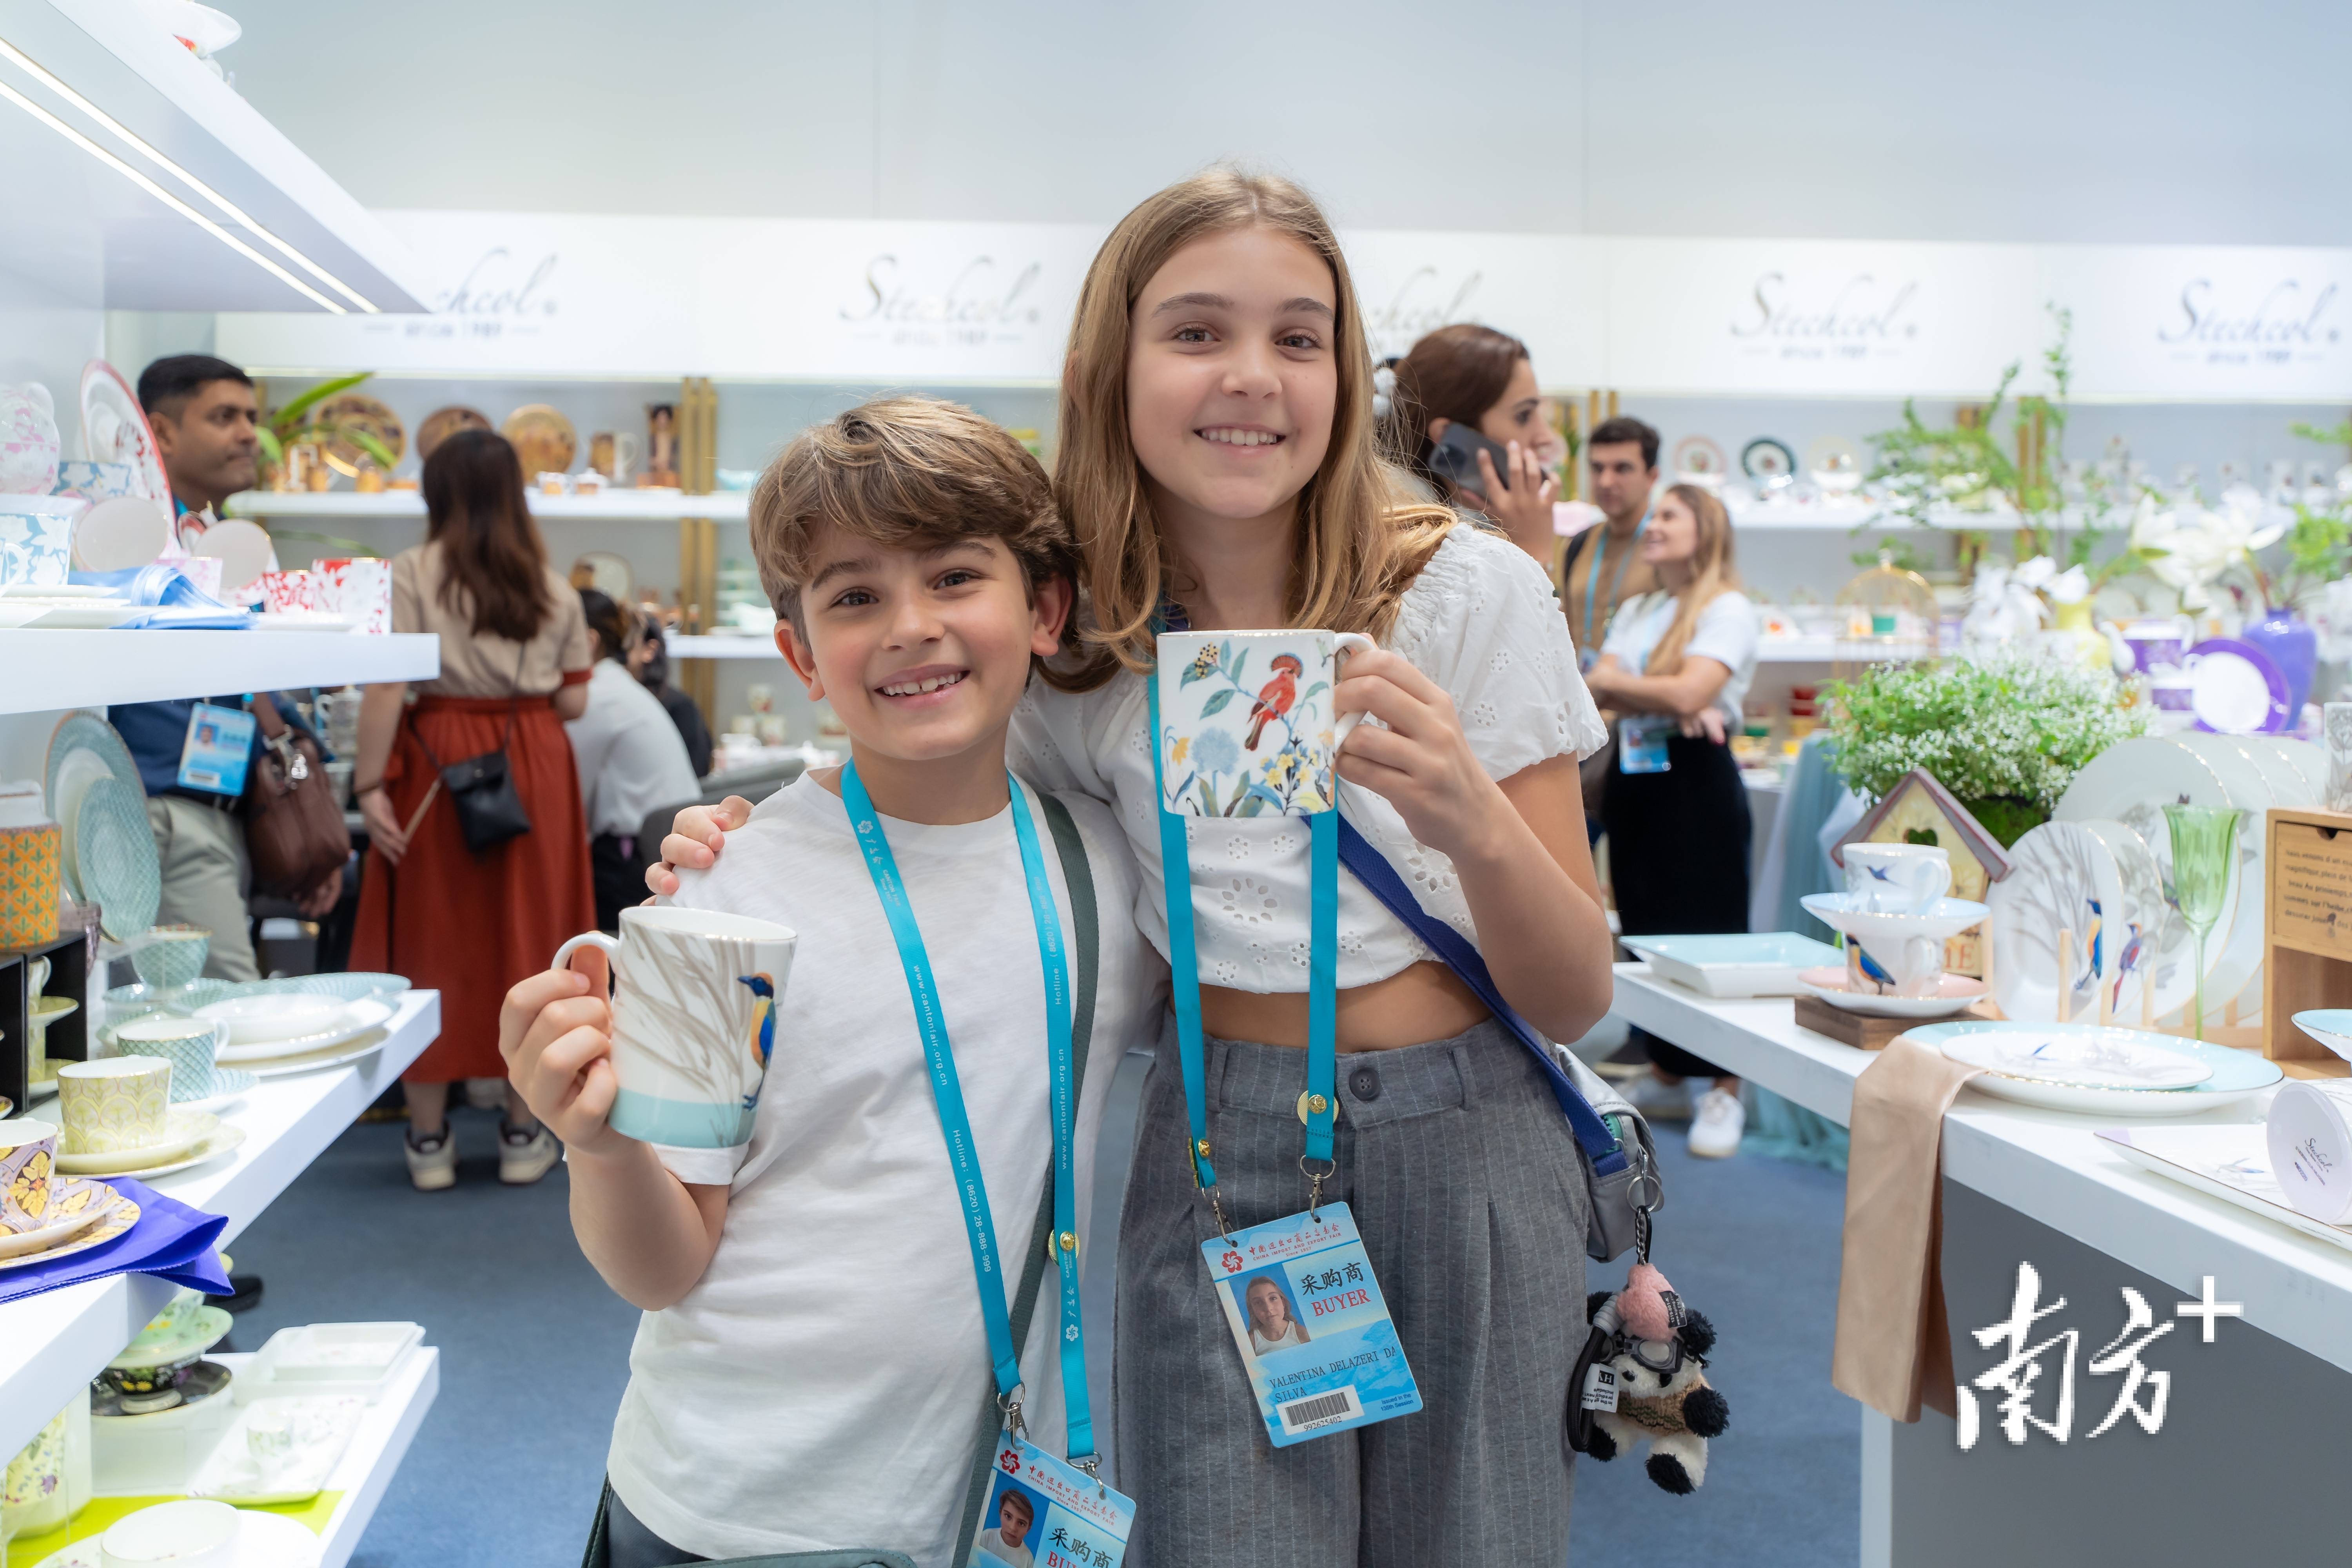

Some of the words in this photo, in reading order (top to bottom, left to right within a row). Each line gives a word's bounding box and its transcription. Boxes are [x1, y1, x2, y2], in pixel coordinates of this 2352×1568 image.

[883, 869, 895, 893] CANTON
[914, 965, 947, 1085] www.cantonfair.org.cn
[953, 1129, 969, 1172] Hotline:
[1272, 1247, 1291, 1255] IMPORT
[1307, 1237, 1327, 1245] EXPORT
[1301, 1261, 1364, 1296] 采购商
[1311, 1289, 1371, 1317] BUYER
[1676, 1298, 1684, 1318] HELENA
[1269, 1366, 1326, 1389] VALENTINA
[1329, 1352, 1379, 1373] DELAZERI
[1383, 1346, 1396, 1357] DA
[1275, 1387, 1307, 1403] SILVA
[1303, 1416, 1342, 1431] 992625402
[1028, 1475, 1044, 1486] CHINA
[1046, 1485, 1065, 1498] IMPORT
[1067, 1497, 1078, 1505] AND
[1081, 1504, 1100, 1518] EXPORT
[1102, 1516, 1114, 1526] FAIR
[1056, 1496, 1069, 1506] Since
[1071, 1504, 1082, 1513] 1957
[1048, 1528, 1113, 1568] 采购商
